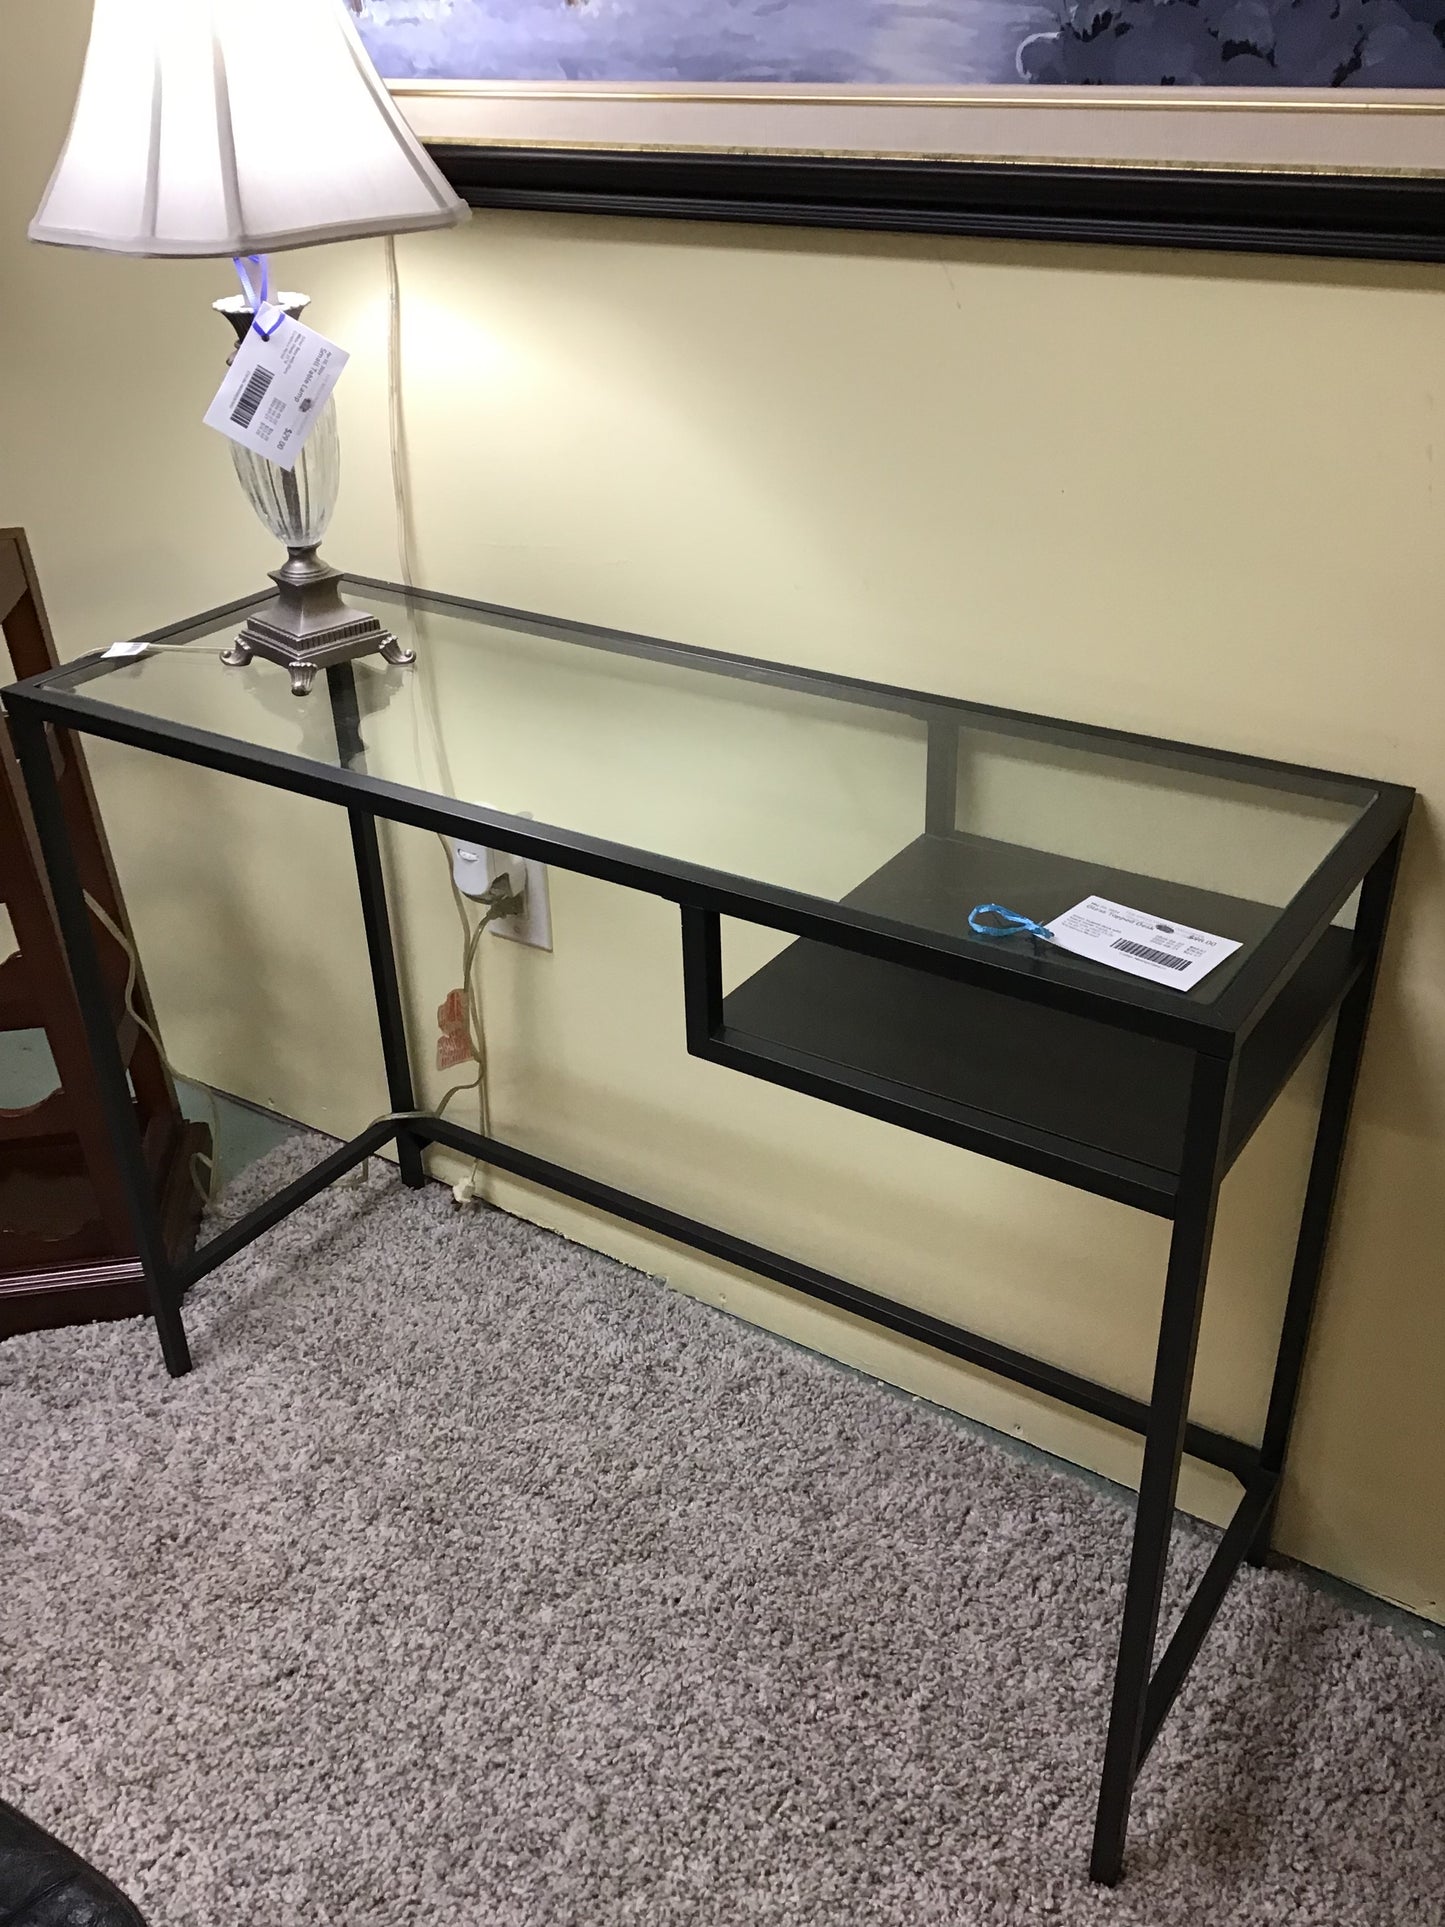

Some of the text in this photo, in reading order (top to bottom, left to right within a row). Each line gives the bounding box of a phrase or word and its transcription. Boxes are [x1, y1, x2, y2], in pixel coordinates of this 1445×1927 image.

[313, 347, 326, 367] Small
[303, 366, 317, 385] Table
[293, 383, 308, 404] Lamp
[276, 427, 292, 451] $29.00
